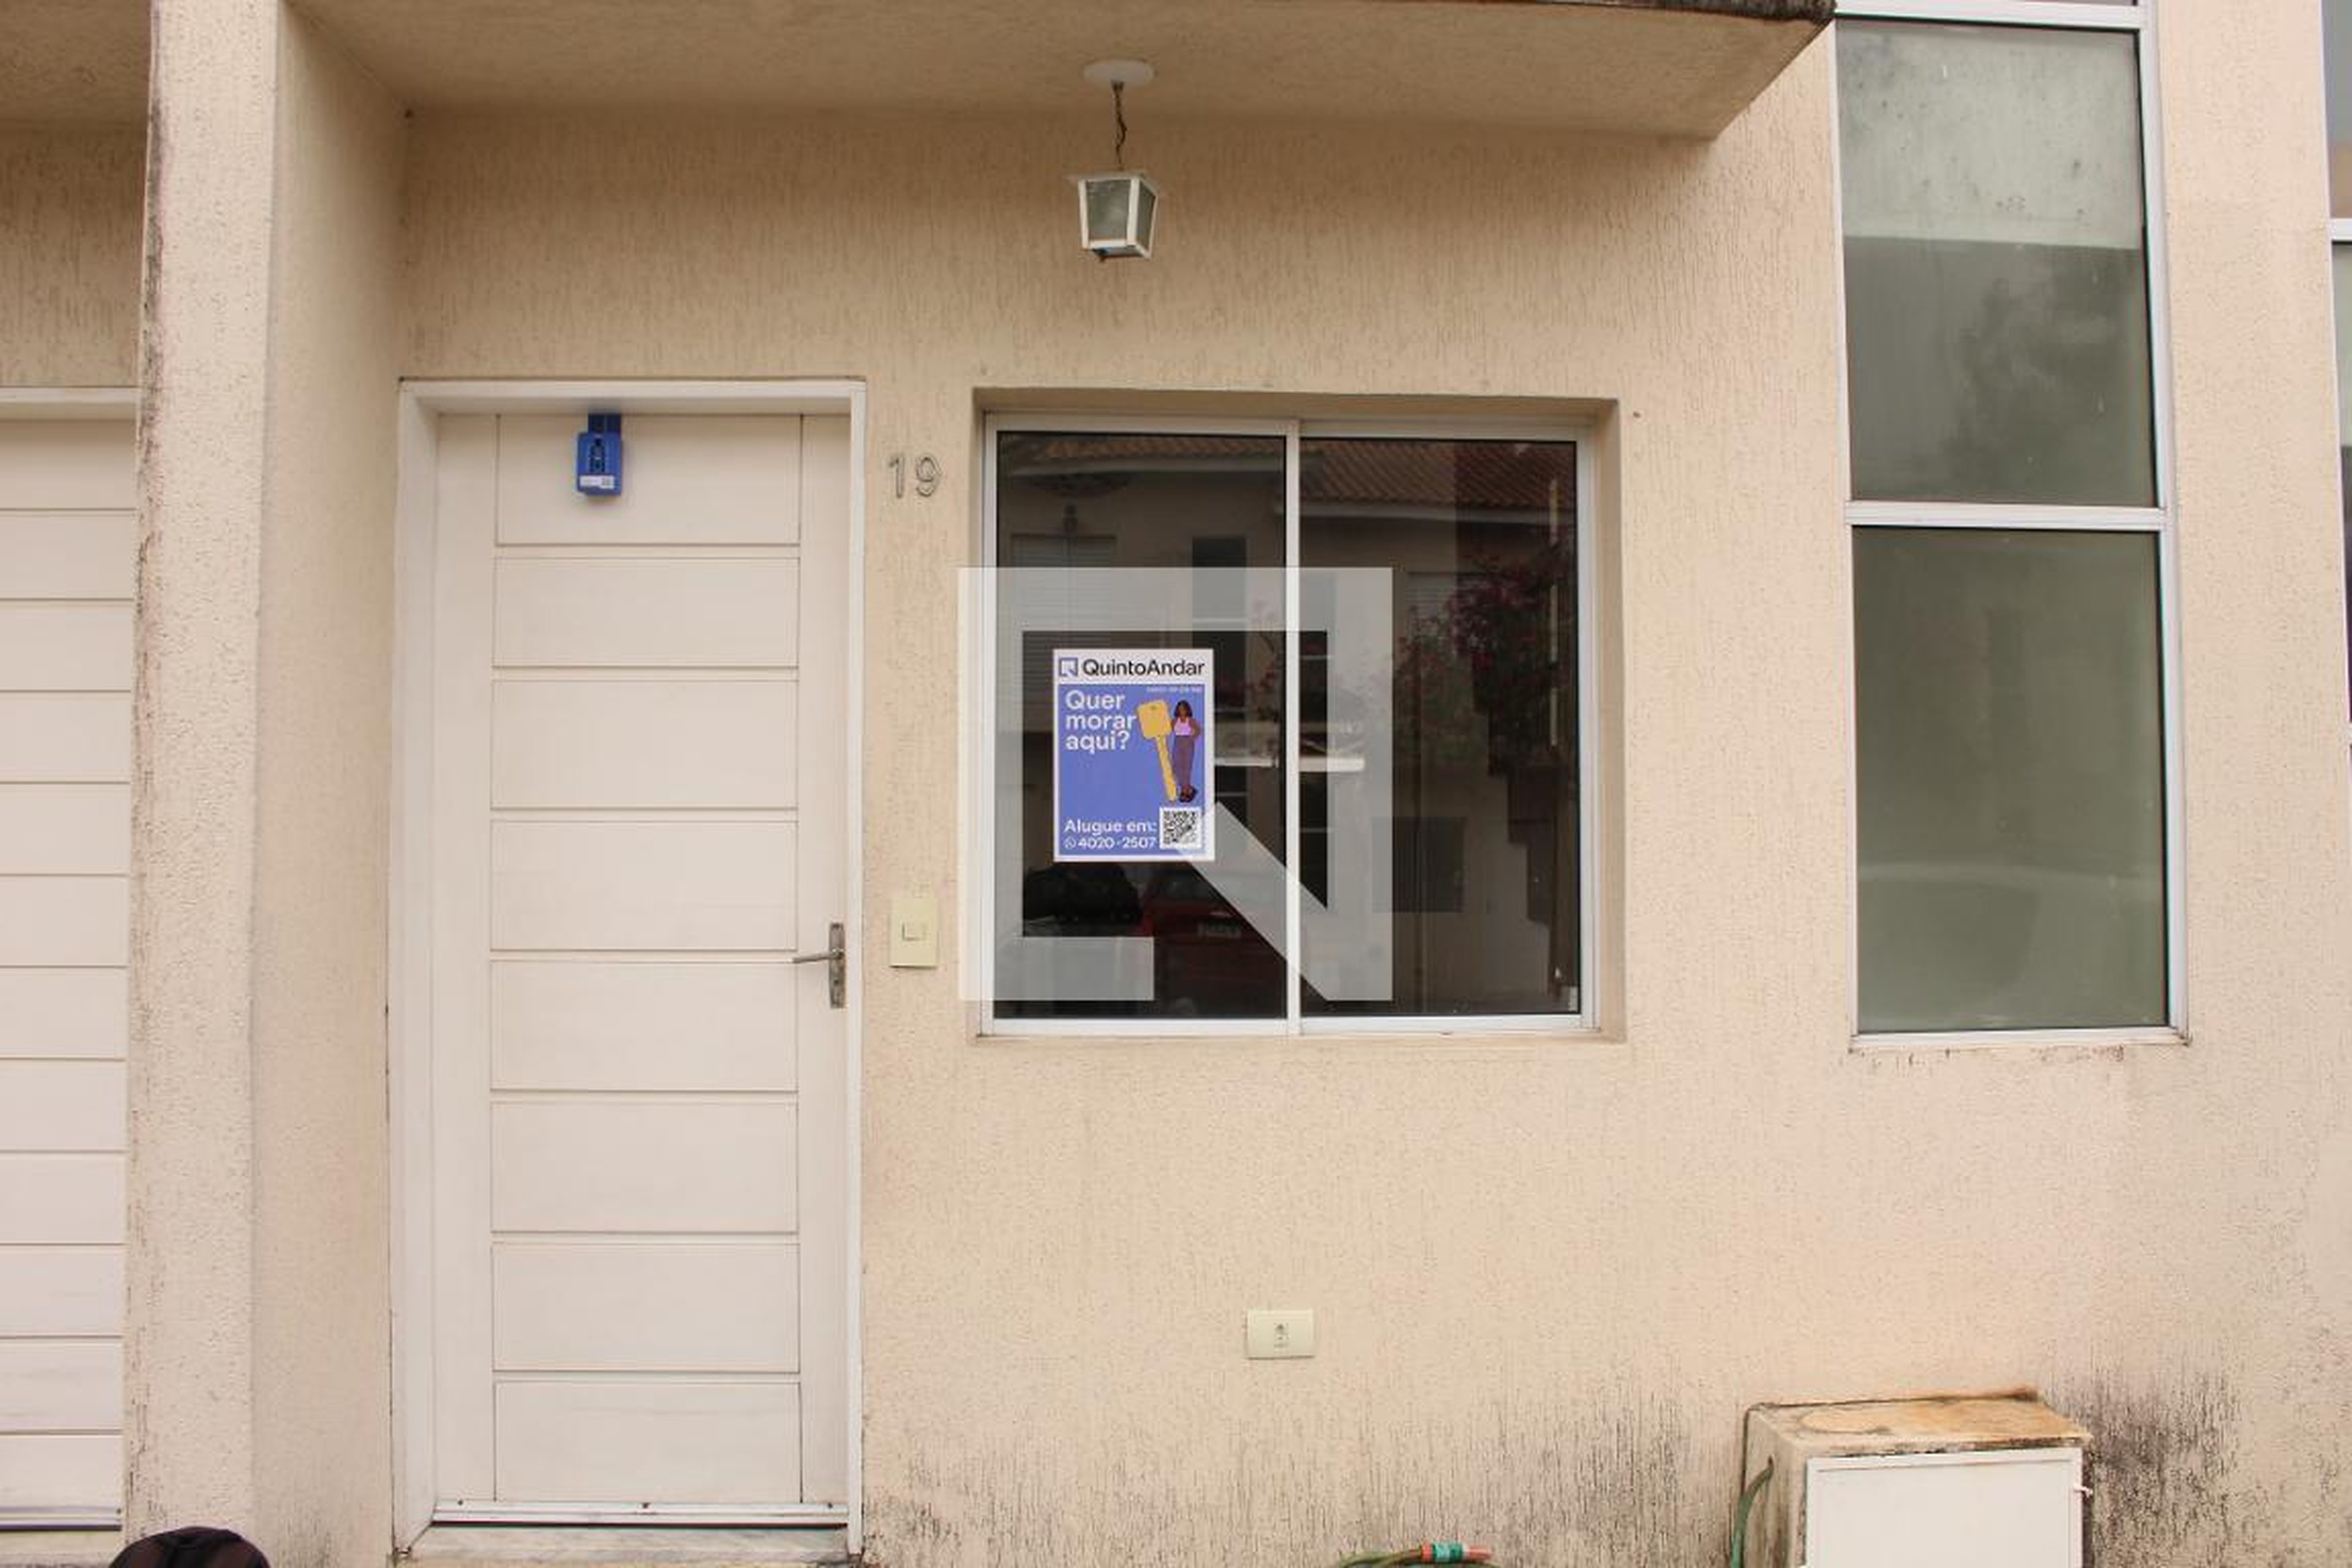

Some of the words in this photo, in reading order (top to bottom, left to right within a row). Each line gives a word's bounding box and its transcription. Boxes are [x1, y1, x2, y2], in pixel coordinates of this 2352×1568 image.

[889, 454, 942, 499] 19
[1082, 658, 1205, 676] QuintoAndar
[1066, 690, 1125, 710] Quer
[1066, 715, 1137, 730] morar
[1066, 730, 1130, 754] aqui?
[1064, 818, 1122, 836] Alugue
[1126, 821, 1157, 833] em:
[1077, 836, 1156, 849] 4020-2507
